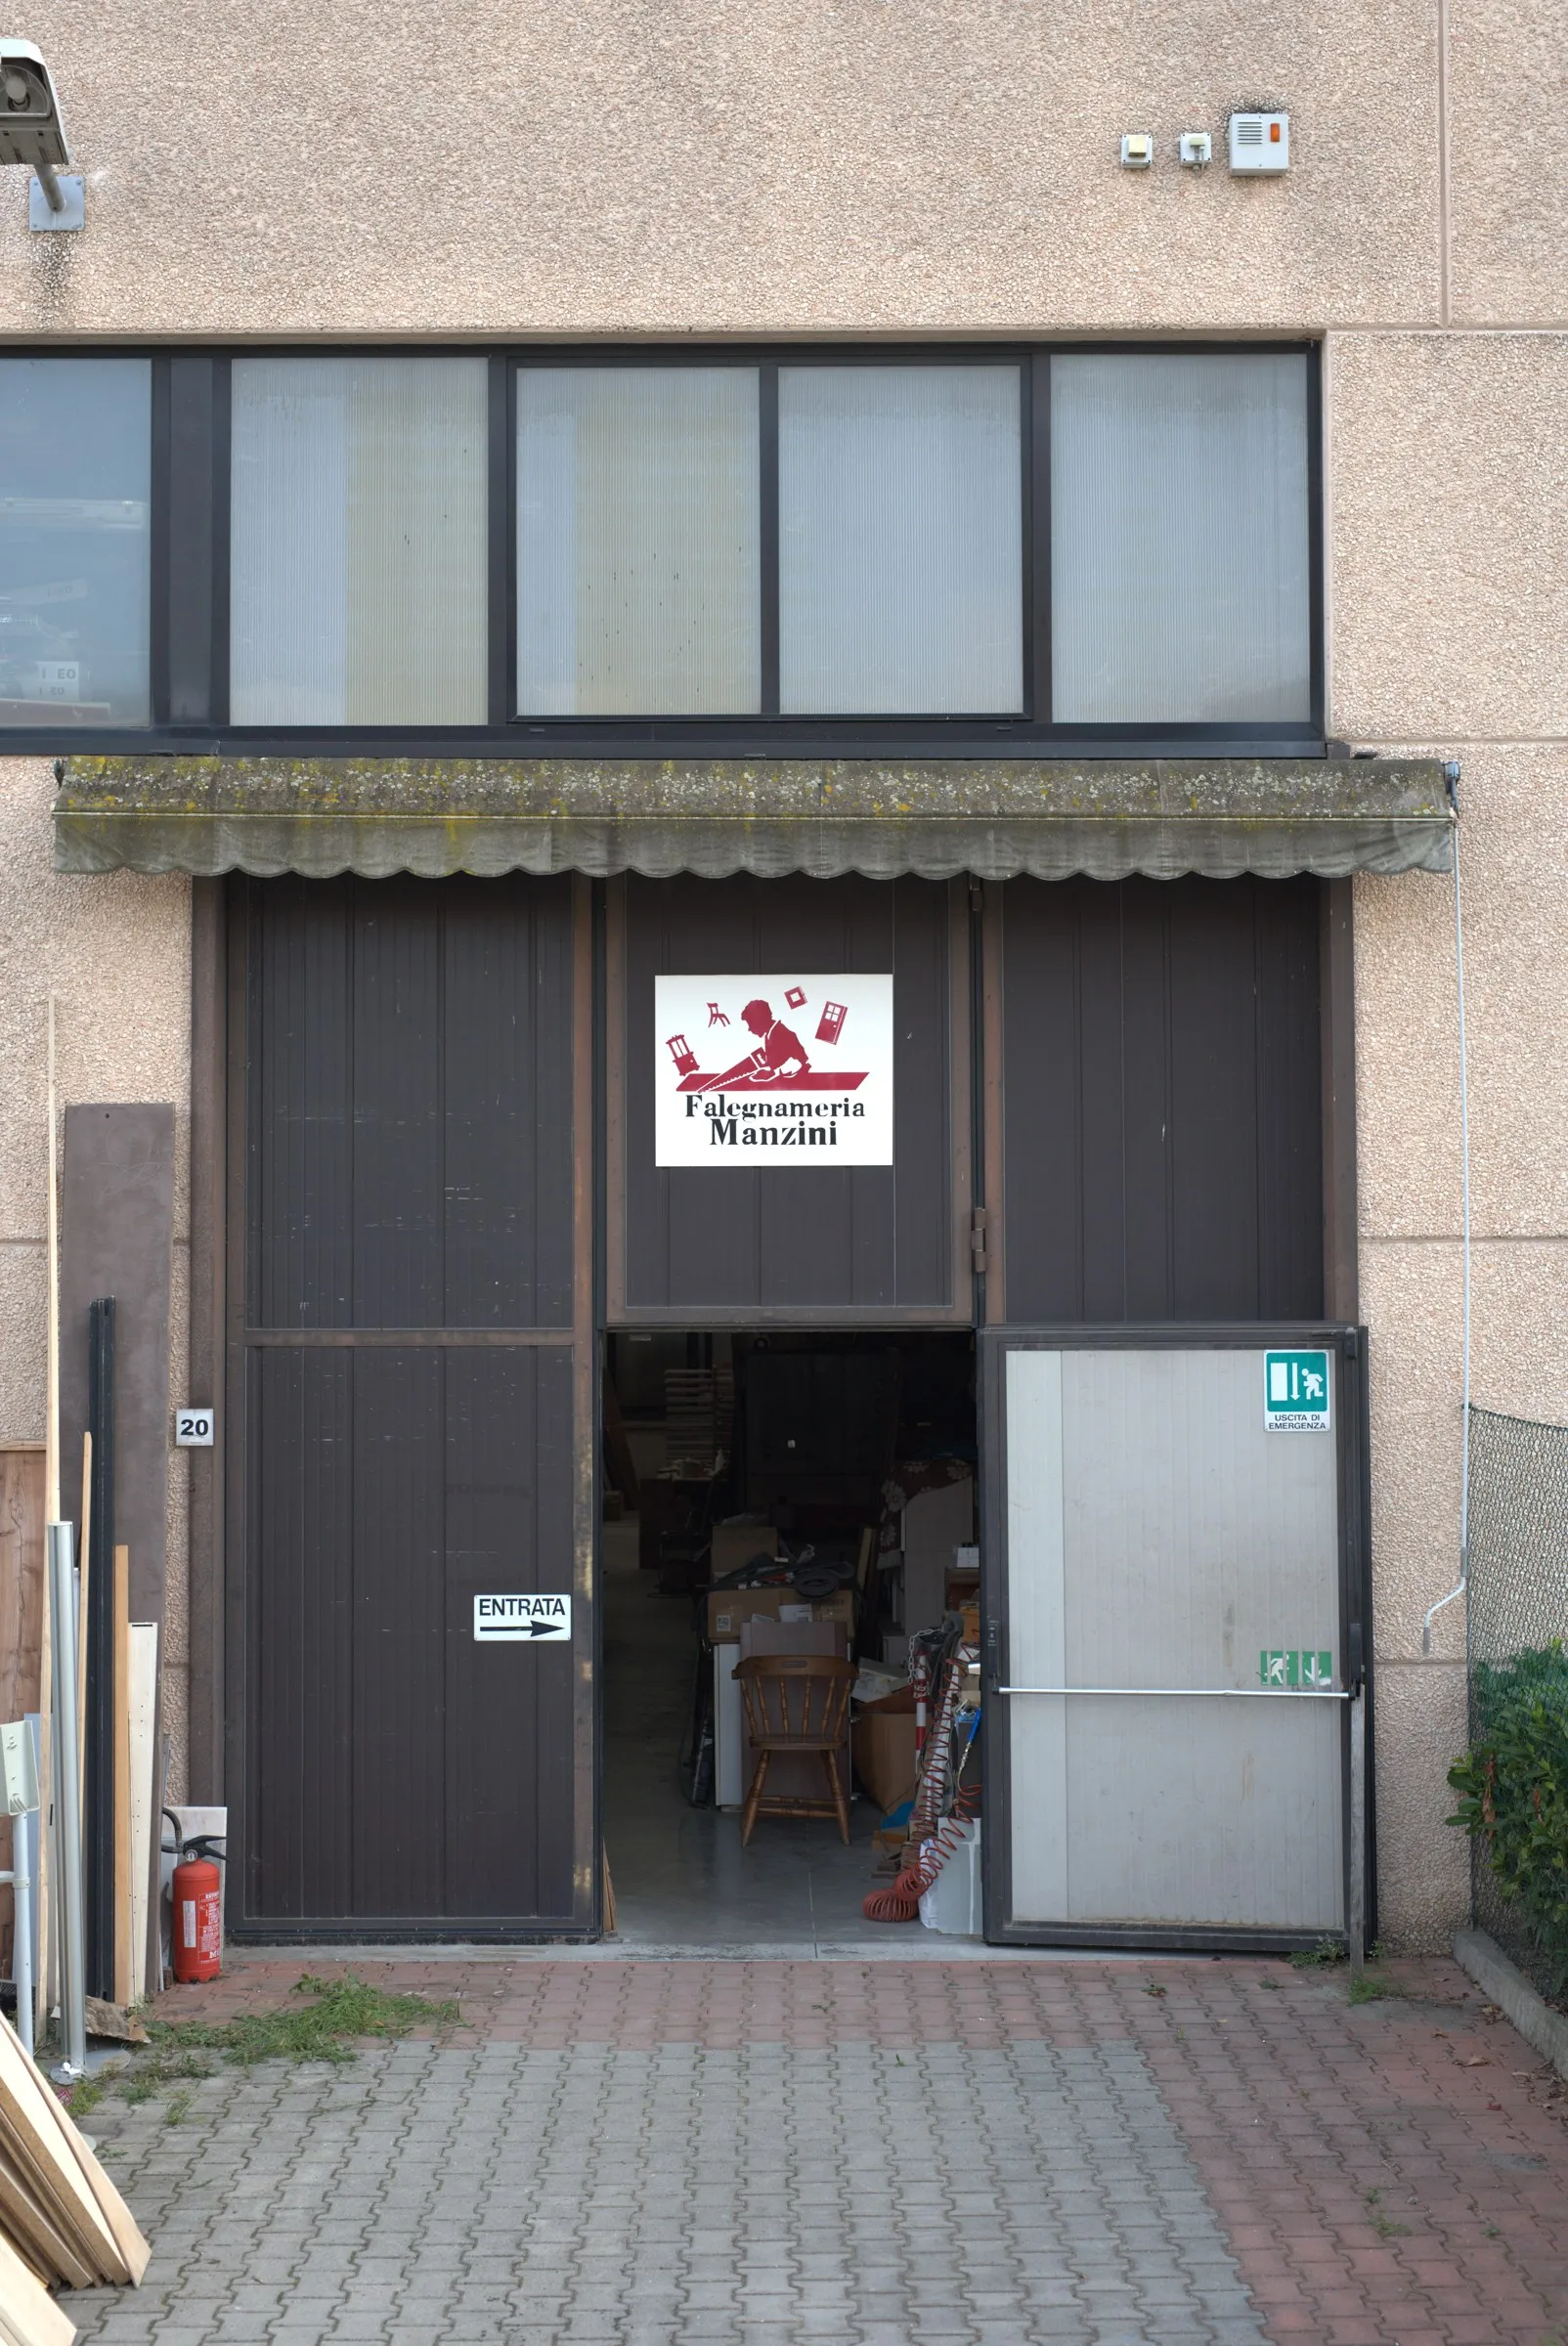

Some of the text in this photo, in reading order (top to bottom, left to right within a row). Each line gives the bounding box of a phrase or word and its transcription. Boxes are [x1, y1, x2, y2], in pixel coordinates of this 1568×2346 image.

[685, 1093, 866, 1123] Falegnameria
[709, 1118, 838, 1146] Manzini
[180, 1418, 209, 1436] 20
[1274, 1413, 1321, 1422] USCITA DI
[479, 1597, 566, 1616] ENTRATA
